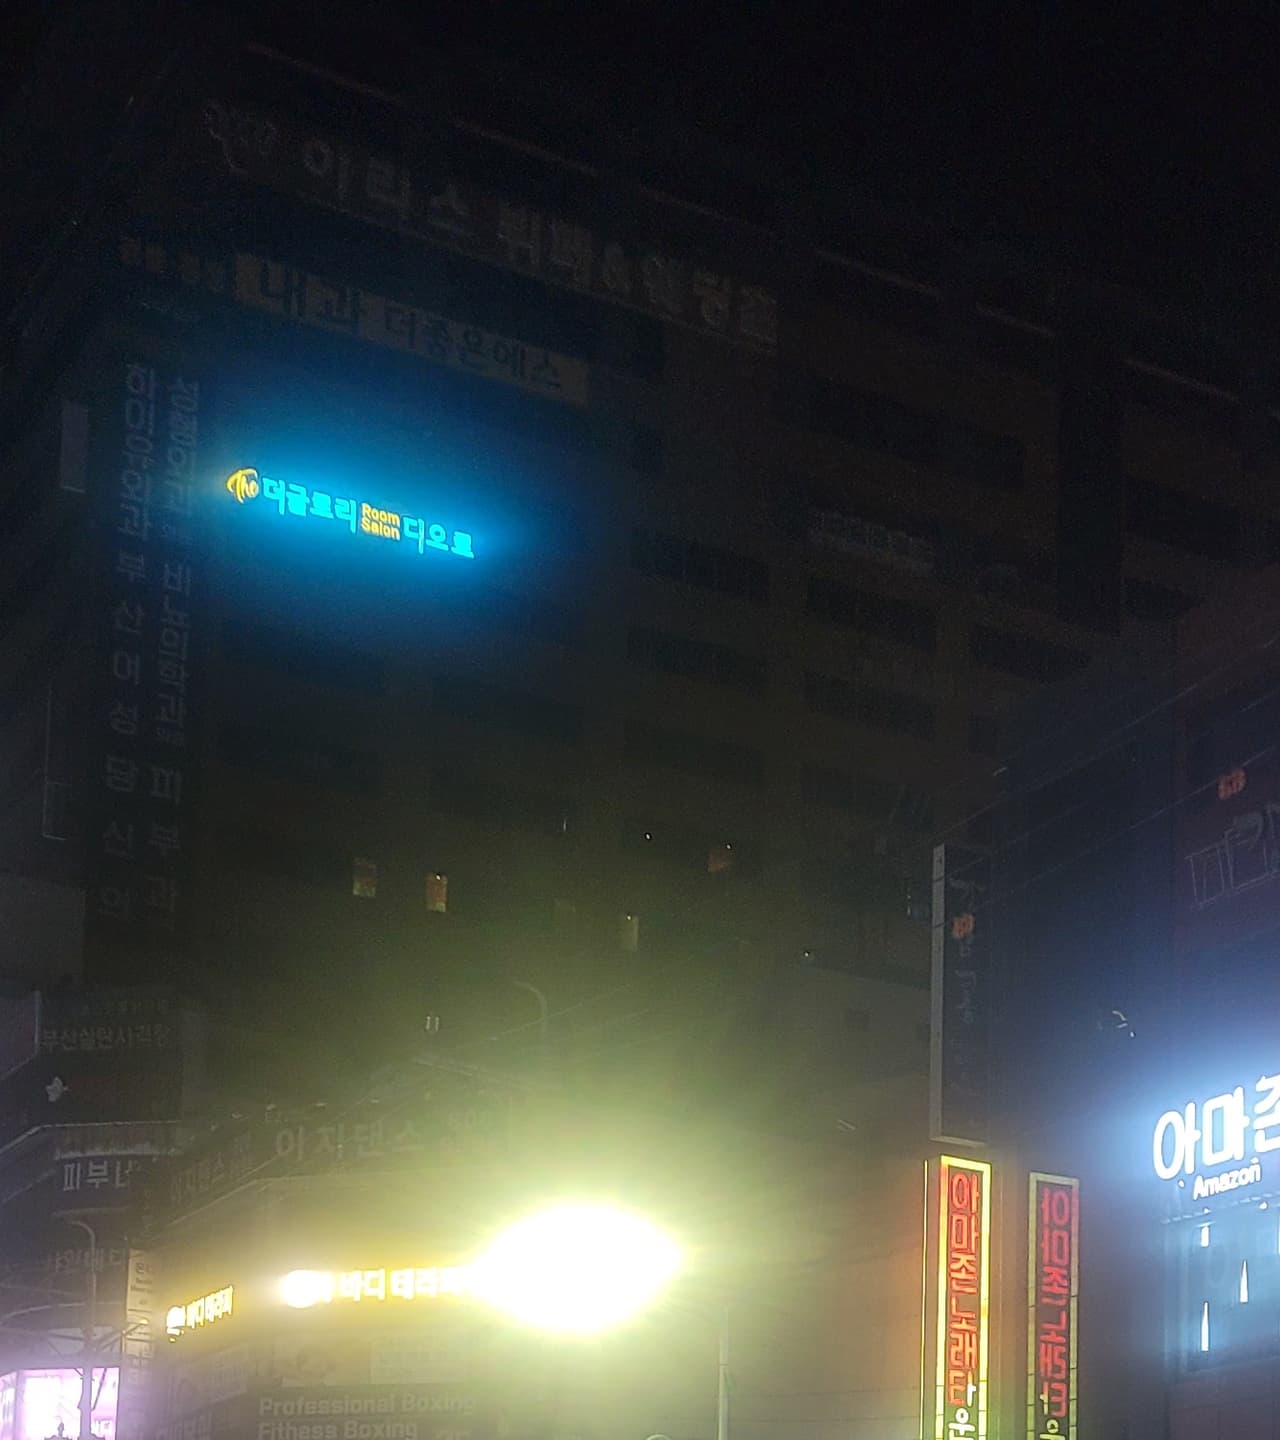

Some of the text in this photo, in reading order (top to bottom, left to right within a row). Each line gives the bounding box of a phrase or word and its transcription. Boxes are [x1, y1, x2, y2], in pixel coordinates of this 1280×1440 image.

[360, 501, 401, 527] Room
[360, 516, 401, 542] Salon
[258, 1393, 476, 1417] Professional Boxing
